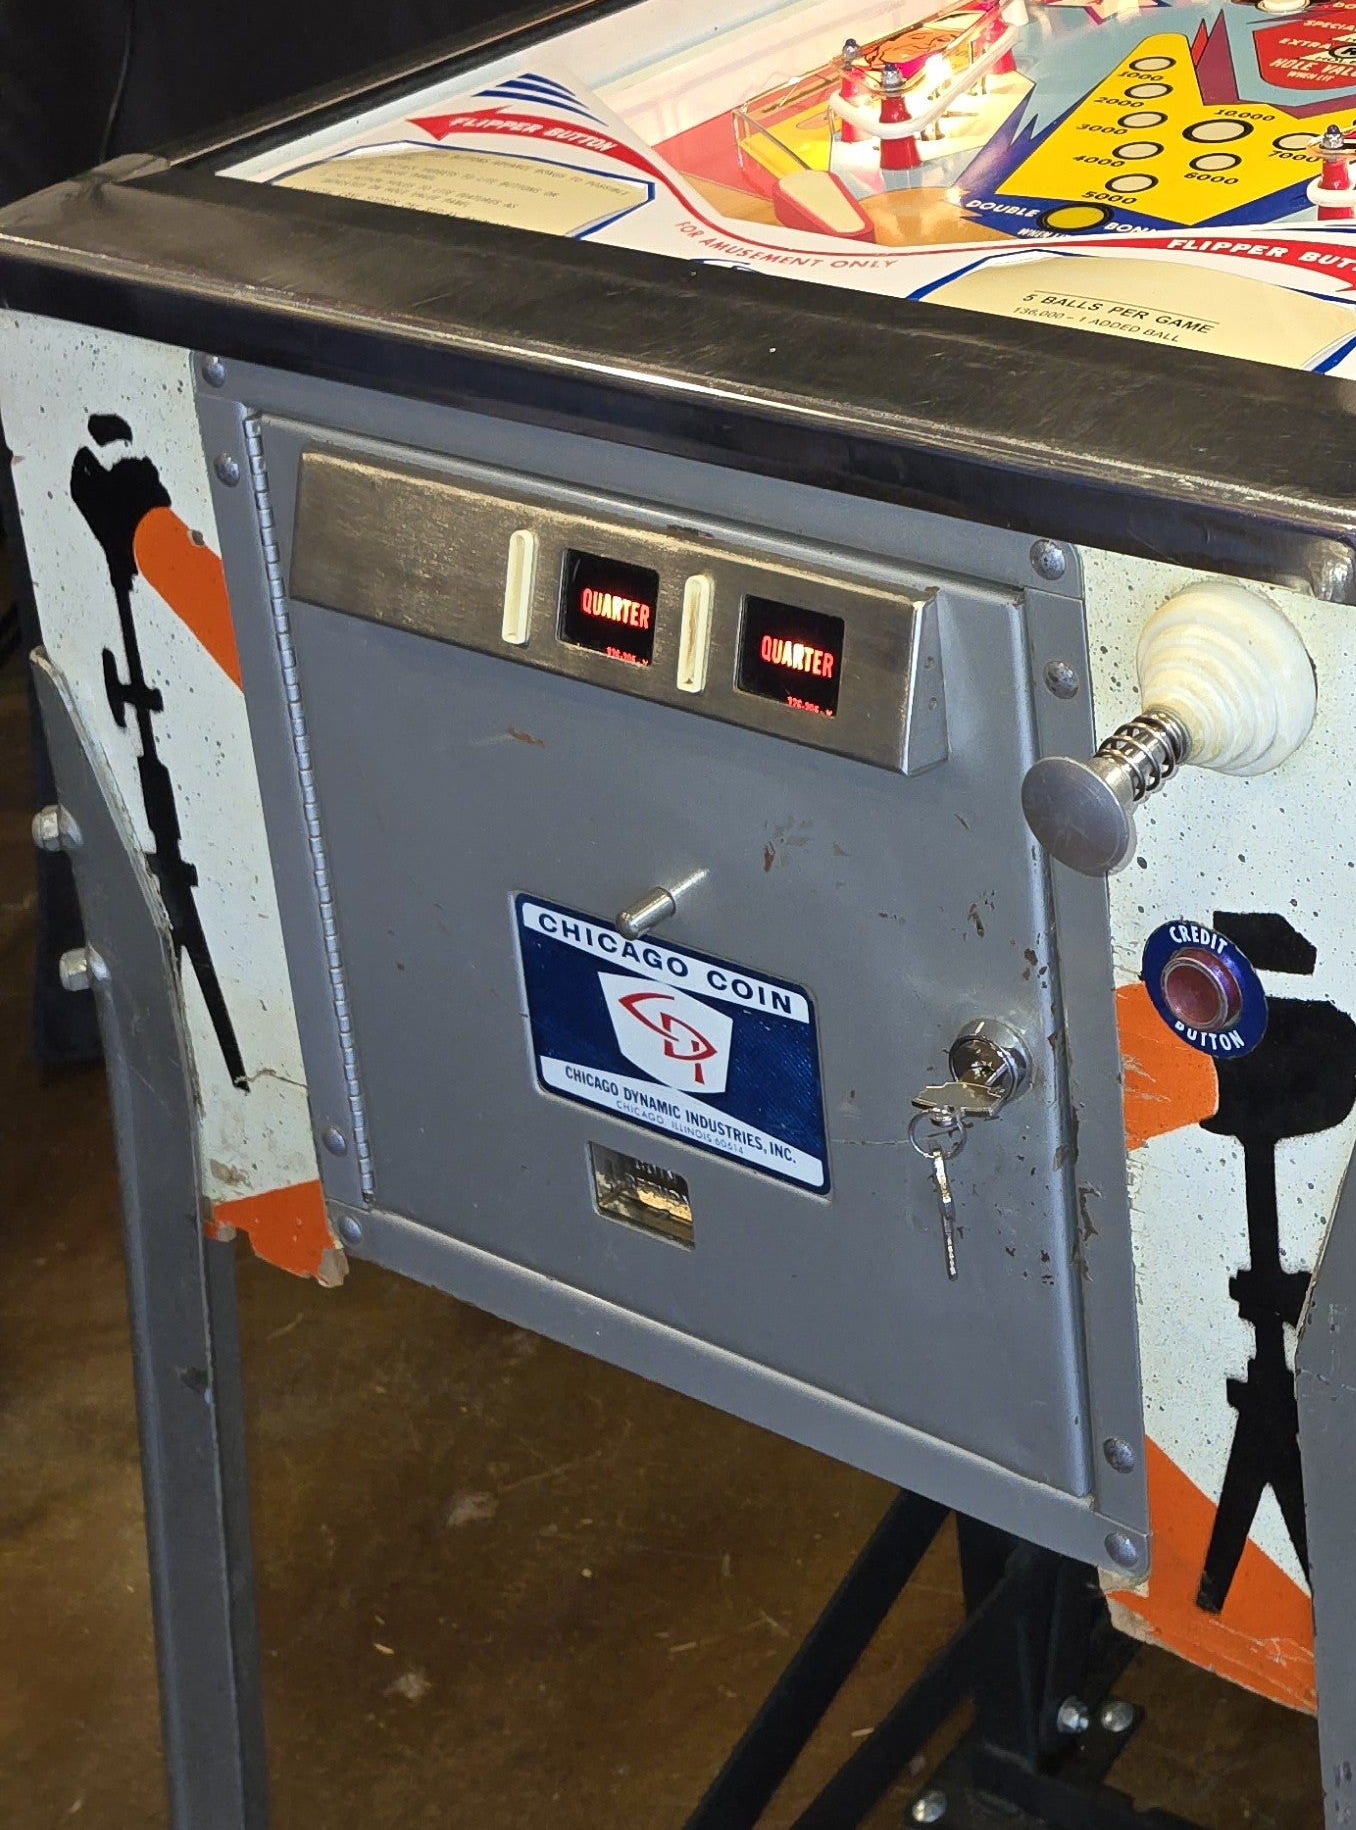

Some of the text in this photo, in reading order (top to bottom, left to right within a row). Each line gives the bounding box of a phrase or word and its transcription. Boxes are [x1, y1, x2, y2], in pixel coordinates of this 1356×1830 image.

[1279, 37, 1332, 50] EXTRA
[1269, 58, 1318, 71] HOLE
[1117, 71, 1164, 81] 1000
[1287, 71, 1317, 81] WHEN
[1093, 96, 1144, 108] 2000
[449, 116, 617, 151] FLIPPER BUTTON
[1076, 123, 1128, 135] 3000
[1072, 155, 1126, 168] 4000
[1267, 150, 1320, 163] 7000
[1183, 172, 1240, 186] 6000
[1081, 190, 1138, 205] 5000
[966, 199, 1040, 218] DOUBLE
[1103, 222, 1158, 234] BON
[675, 220, 900, 269] FOR AMUSEMENT ONLY
[1167, 239, 1289, 258] FLIPPER
[1022, 293, 1215, 334] 5 BALLS PER GAME
[1089, 318, 1141, 333] ADDED
[1143, 327, 1180, 343] BALL
[581, 588, 650, 629] QUARTER
[761, 635, 834, 679] QUARTER
[1169, 925, 1228, 954] CREDIT
[538, 912, 793, 1015] CHICAGO COIN
[1174, 1020, 1245, 1051] BUTTON
[565, 1065, 797, 1164] CHICAGO DYNAMIC INDUSTRIES, INC.
[671, 1121, 713, 1145] ILLINOIS
